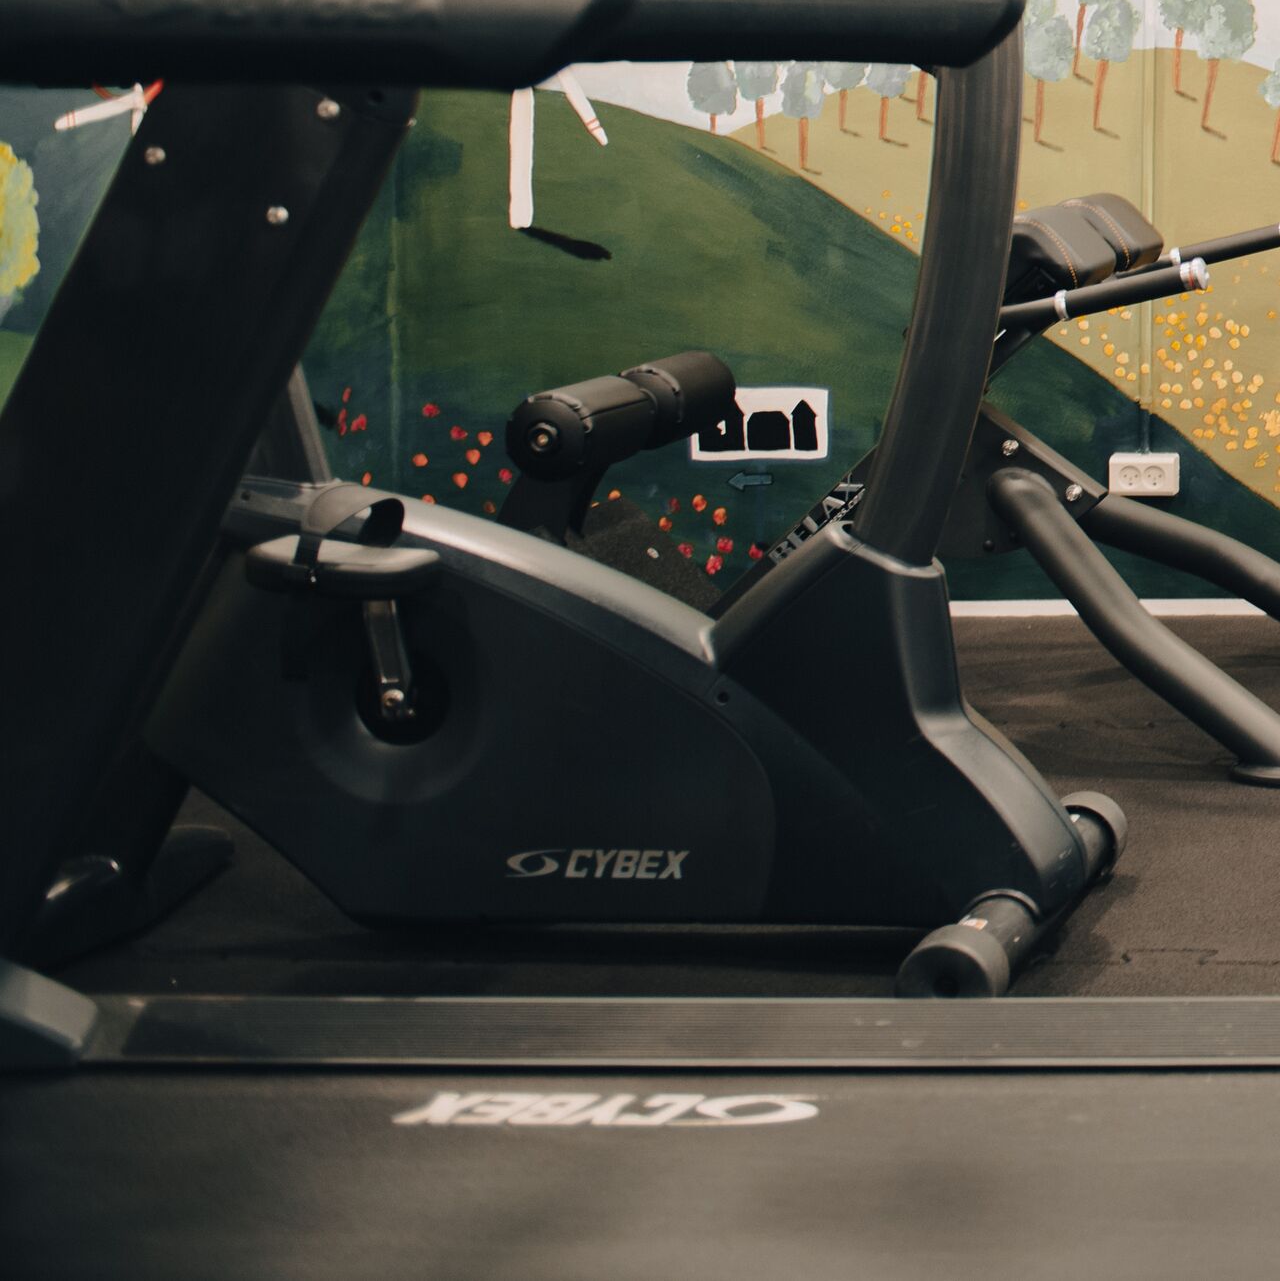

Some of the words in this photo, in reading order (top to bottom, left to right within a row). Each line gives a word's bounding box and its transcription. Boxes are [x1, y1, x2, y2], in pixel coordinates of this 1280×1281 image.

[767, 470, 866, 565] RELAX
[565, 848, 690, 879] CYBEX
[393, 1091, 705, 1125] CYBEX
